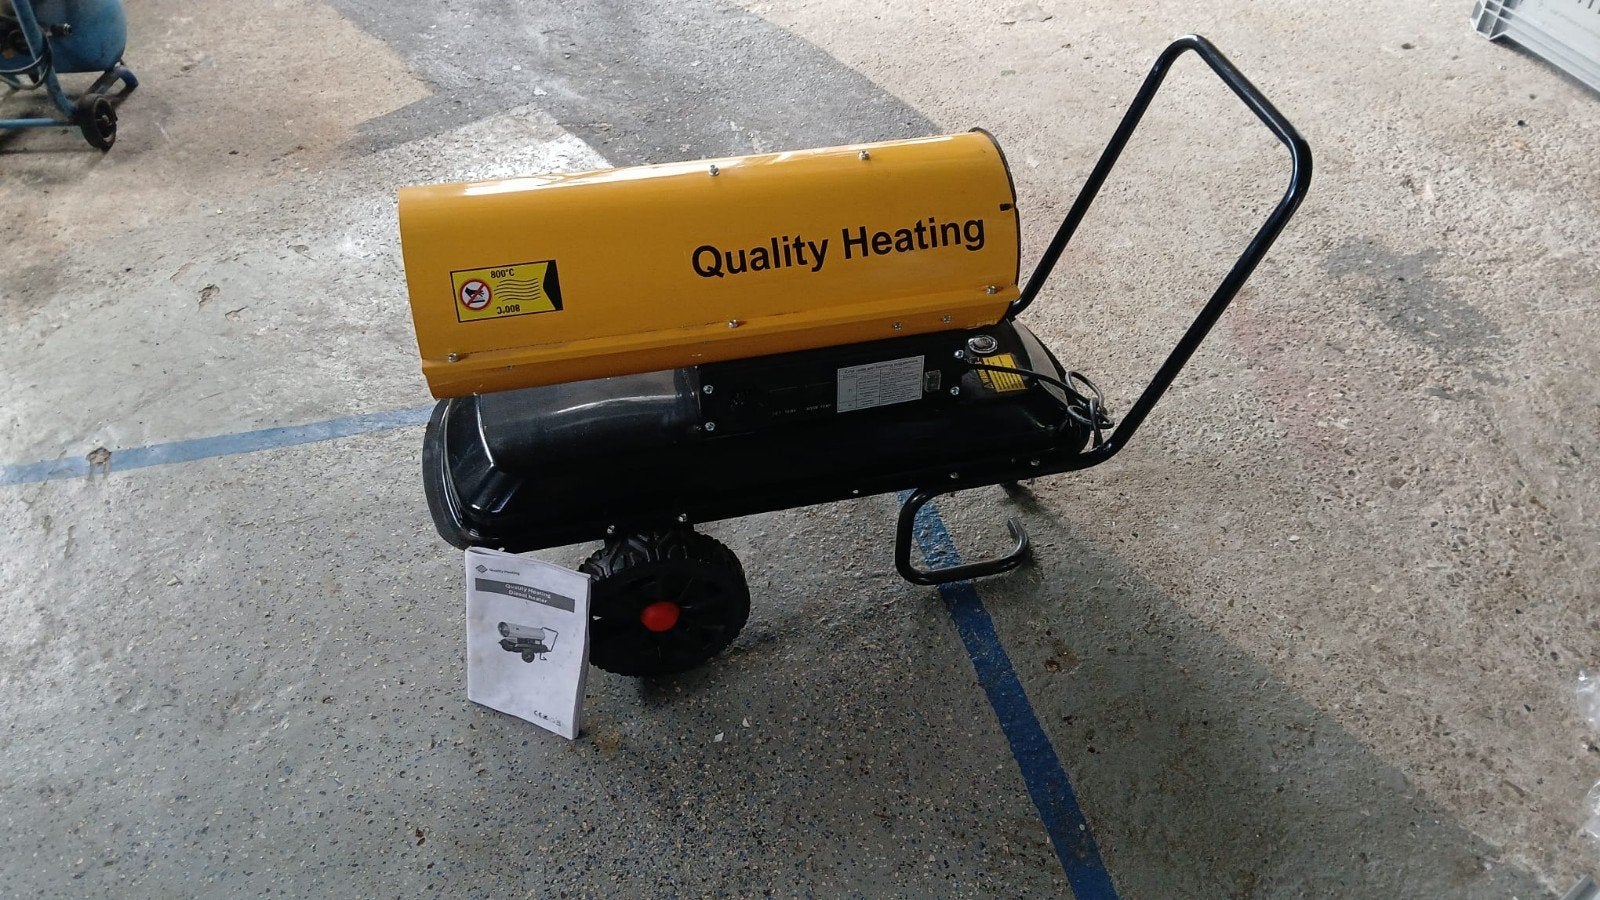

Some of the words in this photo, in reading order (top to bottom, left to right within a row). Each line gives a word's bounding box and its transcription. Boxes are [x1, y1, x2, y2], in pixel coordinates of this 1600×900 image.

[691, 235, 828, 278] Quality
[842, 217, 985, 259] Heating
[490, 268, 515, 279] 800°C
[496, 304, 521, 315] 800°C
[505, 583, 527, 593] Quality
[528, 588, 551, 599] Heating
[508, 590, 528, 599] Diesel
